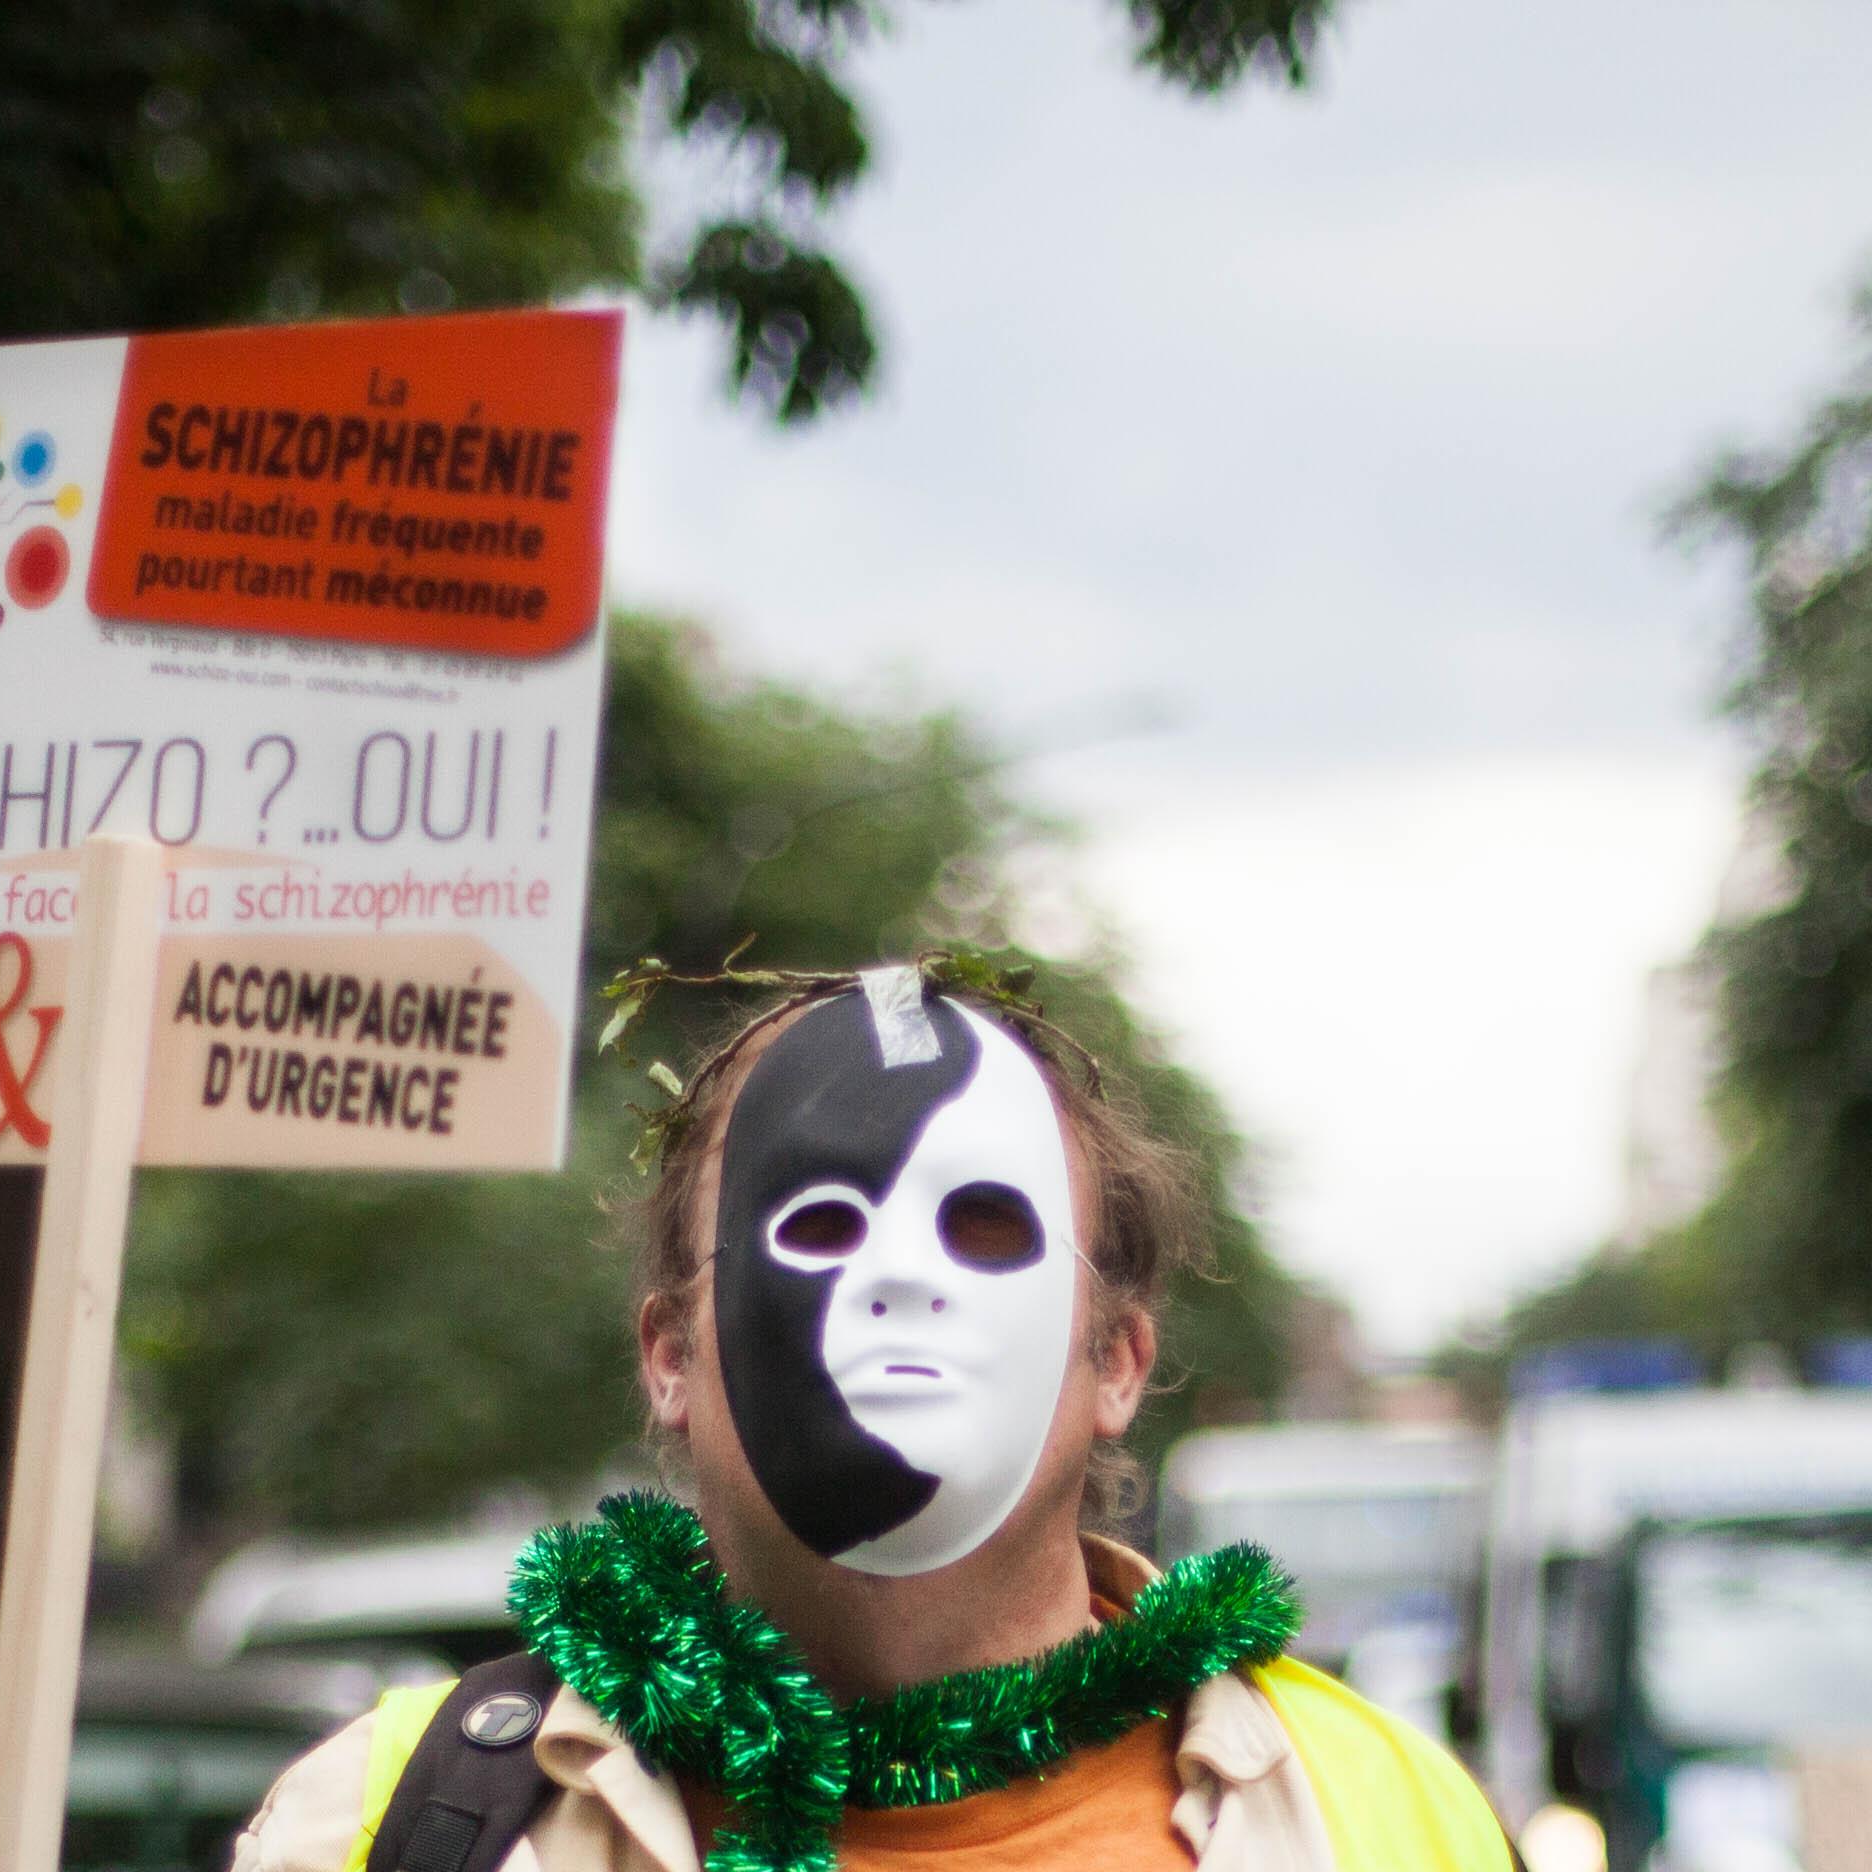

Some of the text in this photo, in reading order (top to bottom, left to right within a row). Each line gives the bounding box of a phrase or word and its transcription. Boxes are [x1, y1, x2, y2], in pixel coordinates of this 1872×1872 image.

[368, 367, 409, 406] La
[140, 401, 581, 501] SCHIZOPHRÉNIE
[154, 492, 545, 560] maladie fréquente
[134, 552, 549, 622] pourtant méconnue
[4, 874, 77, 923] fac
[166, 871, 209, 921] la
[234, 867, 550, 930] schizophrénie
[173, 959, 513, 1059] ACCOMPAGNÉE
[202, 1042, 461, 1135] D'URGENCE
